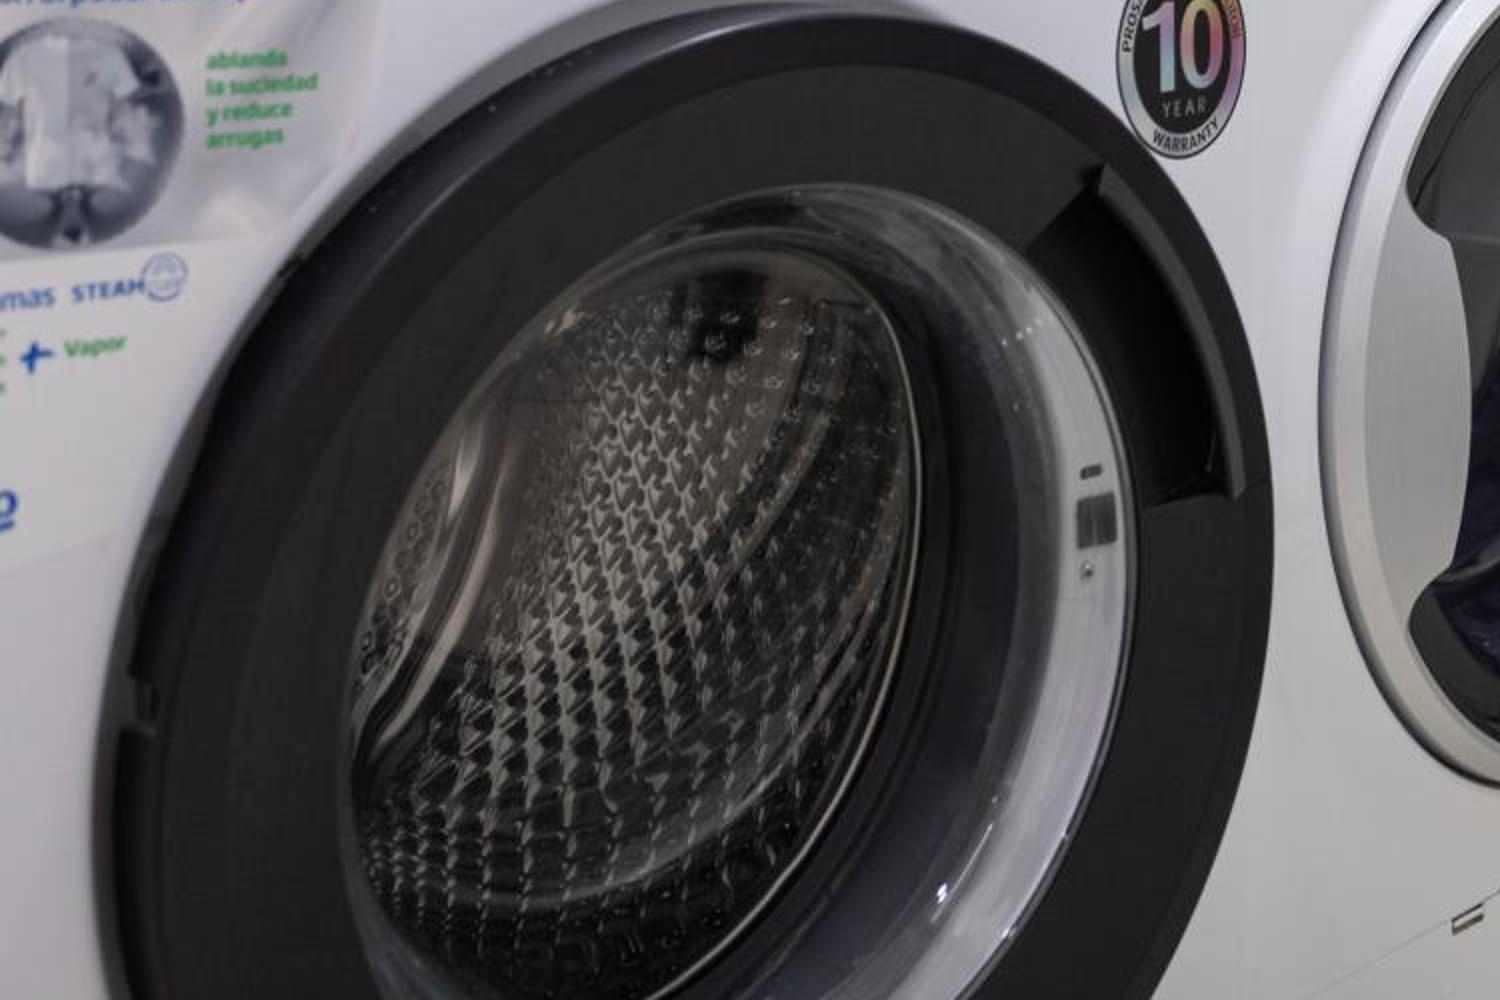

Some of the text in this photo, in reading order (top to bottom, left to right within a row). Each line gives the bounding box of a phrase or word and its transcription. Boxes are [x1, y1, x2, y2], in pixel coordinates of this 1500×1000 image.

[205, 47, 289, 71] ablanda
[229, 72, 320, 96] suciedad
[223, 102, 294, 121] reduce
[1161, 97, 1207, 119] YEAR
[205, 128, 285, 152] arrugas
[1152, 117, 1219, 153] WARRANTY
[71, 278, 146, 304] STEAM
[63, 335, 128, 359] Vapor
